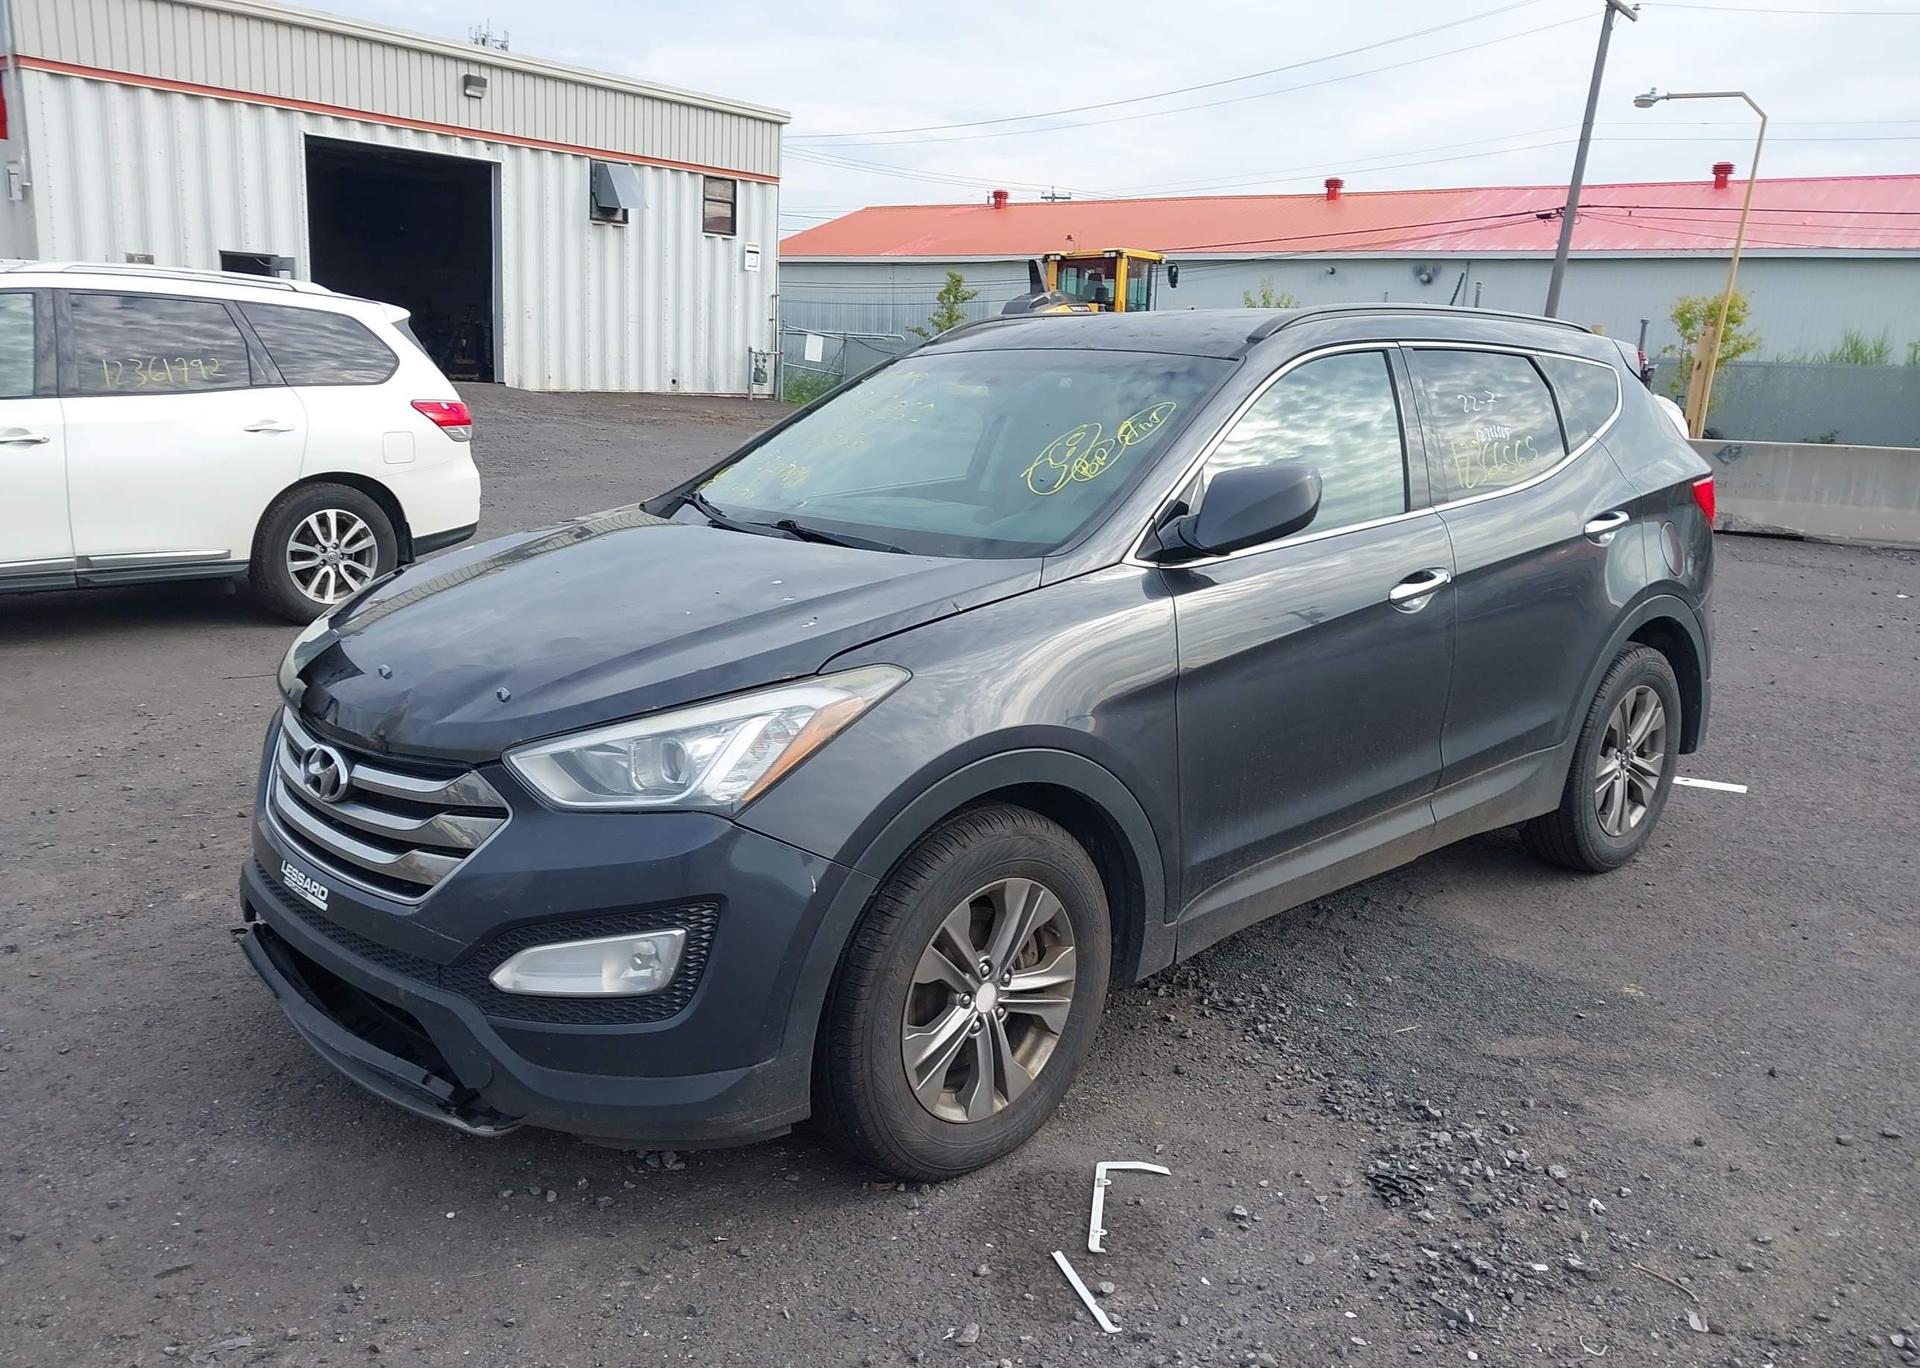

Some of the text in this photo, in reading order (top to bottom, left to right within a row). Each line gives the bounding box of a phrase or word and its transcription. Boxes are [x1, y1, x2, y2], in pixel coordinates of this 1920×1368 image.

[102, 356, 225, 387] 12361792
[1457, 391, 1497, 413] 22-7
[280, 860, 329, 901] LESSARD
